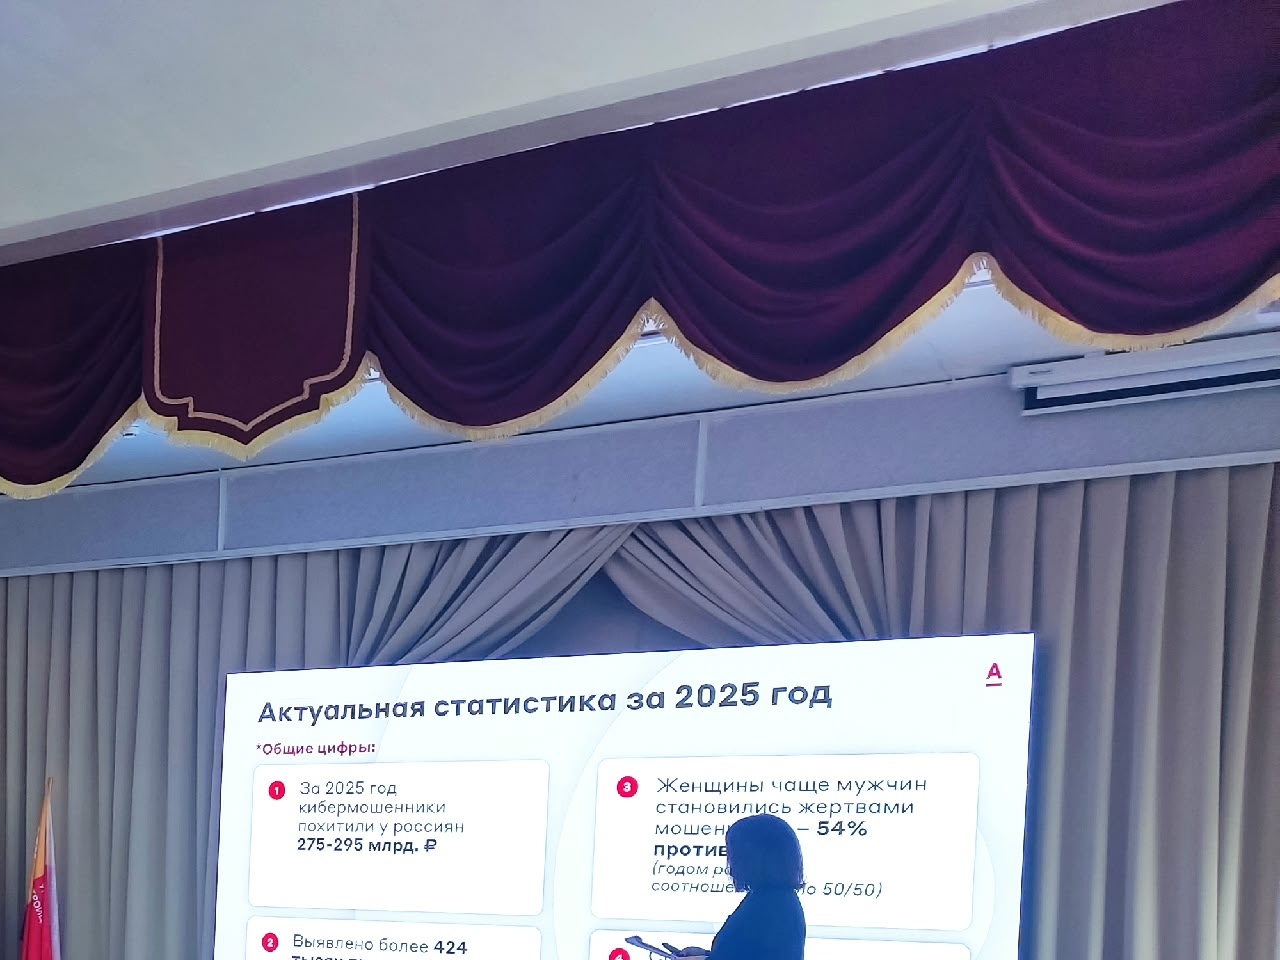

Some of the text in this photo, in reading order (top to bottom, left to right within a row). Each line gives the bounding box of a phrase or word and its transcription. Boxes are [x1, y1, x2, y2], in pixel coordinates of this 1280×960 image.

[258, 682, 832, 725] Актуальная статистика за 2025 год
[318, 741, 375, 756] цифры:
[300, 781, 396, 796] За 2025 год
[657, 778, 926, 796] Женщины чаще мужчин
[300, 800, 445, 817] кибермошенники
[655, 799, 913, 818] становились жертвами
[299, 823, 463, 836] похитили у россиян
[655, 823, 729, 835] мошен
[817, 821, 867, 836] 54%
[298, 838, 437, 854] 275-295 млрд. ₽
[653, 860, 708, 876] (годом
[823, 883, 882, 899] 50/50)
[294, 934, 467, 954] Выявлено более 424
